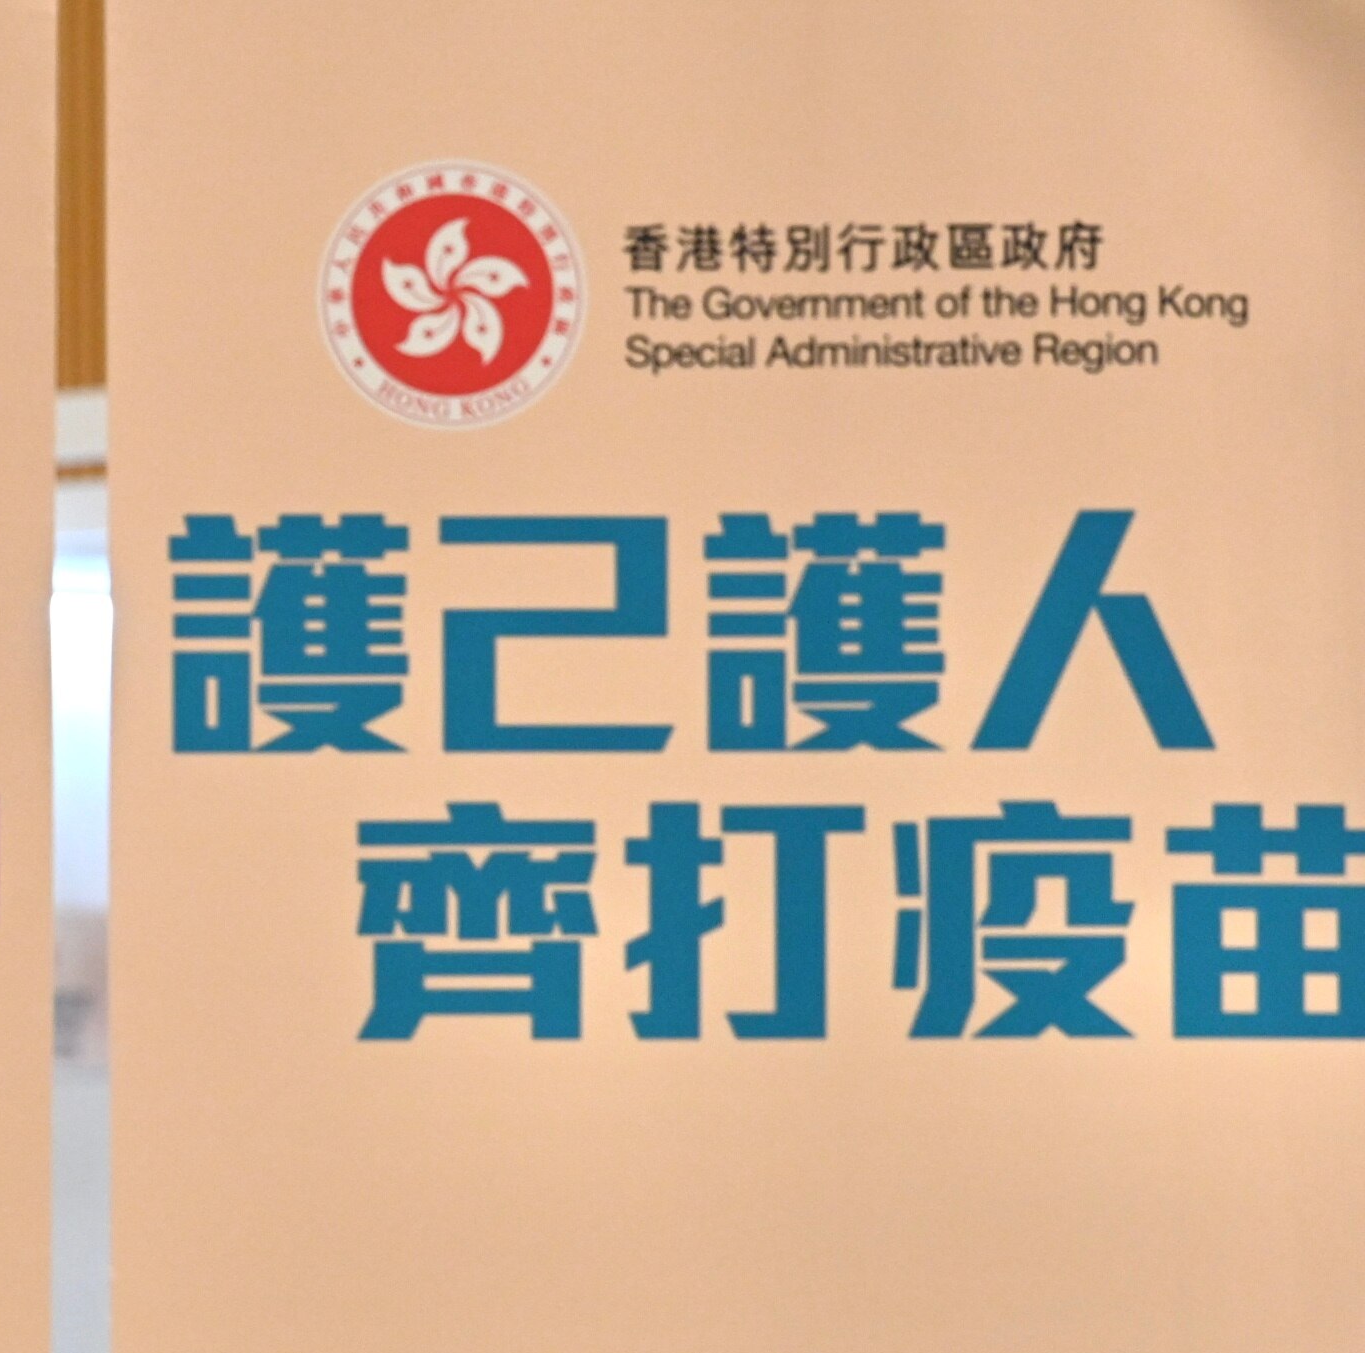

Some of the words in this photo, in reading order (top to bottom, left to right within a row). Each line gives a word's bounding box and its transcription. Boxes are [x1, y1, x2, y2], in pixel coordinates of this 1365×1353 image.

[623, 221, 1103, 273] 香港特別行政區政府
[623, 285, 692, 321] The
[702, 285, 926, 321] Government
[935, 285, 972, 319] of
[981, 285, 1038, 318] the
[1048, 285, 1147, 325] Hong
[1158, 285, 1249, 327] Kong
[624, 335, 756, 375] Special
[765, 333, 1021, 369] Administrative
[1032, 332, 1160, 374] Region
[168, 509, 1218, 753] 護己護人
[356, 800, 1365, 1041] 齊打疫苗
